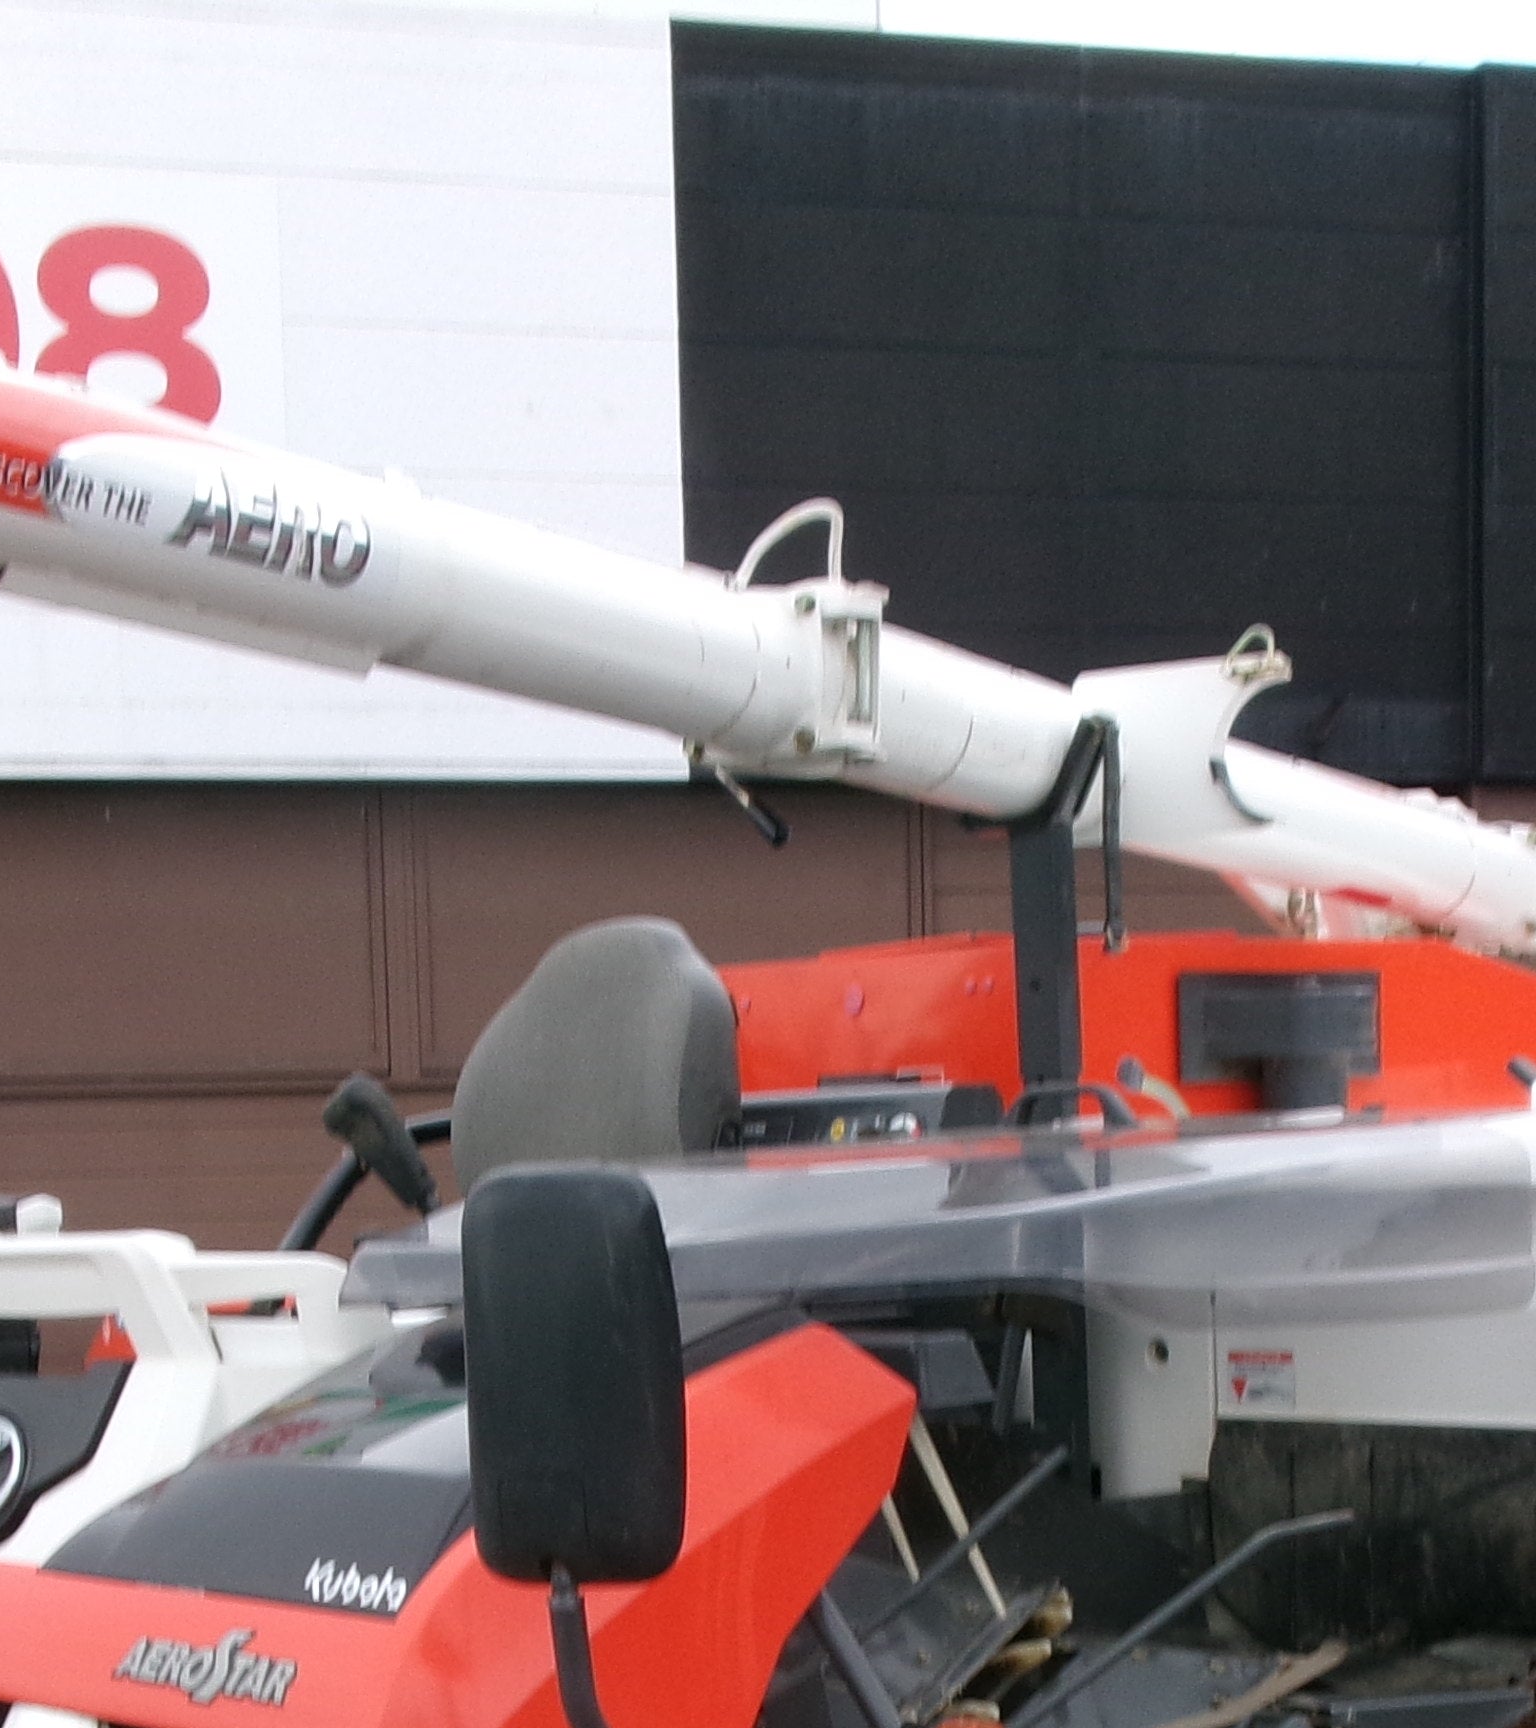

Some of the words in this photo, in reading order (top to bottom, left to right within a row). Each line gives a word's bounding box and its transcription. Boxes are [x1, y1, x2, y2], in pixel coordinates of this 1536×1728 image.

[103, 482, 154, 527] THE
[167, 466, 372, 588] AERO
[304, 1556, 408, 1613] Kubota
